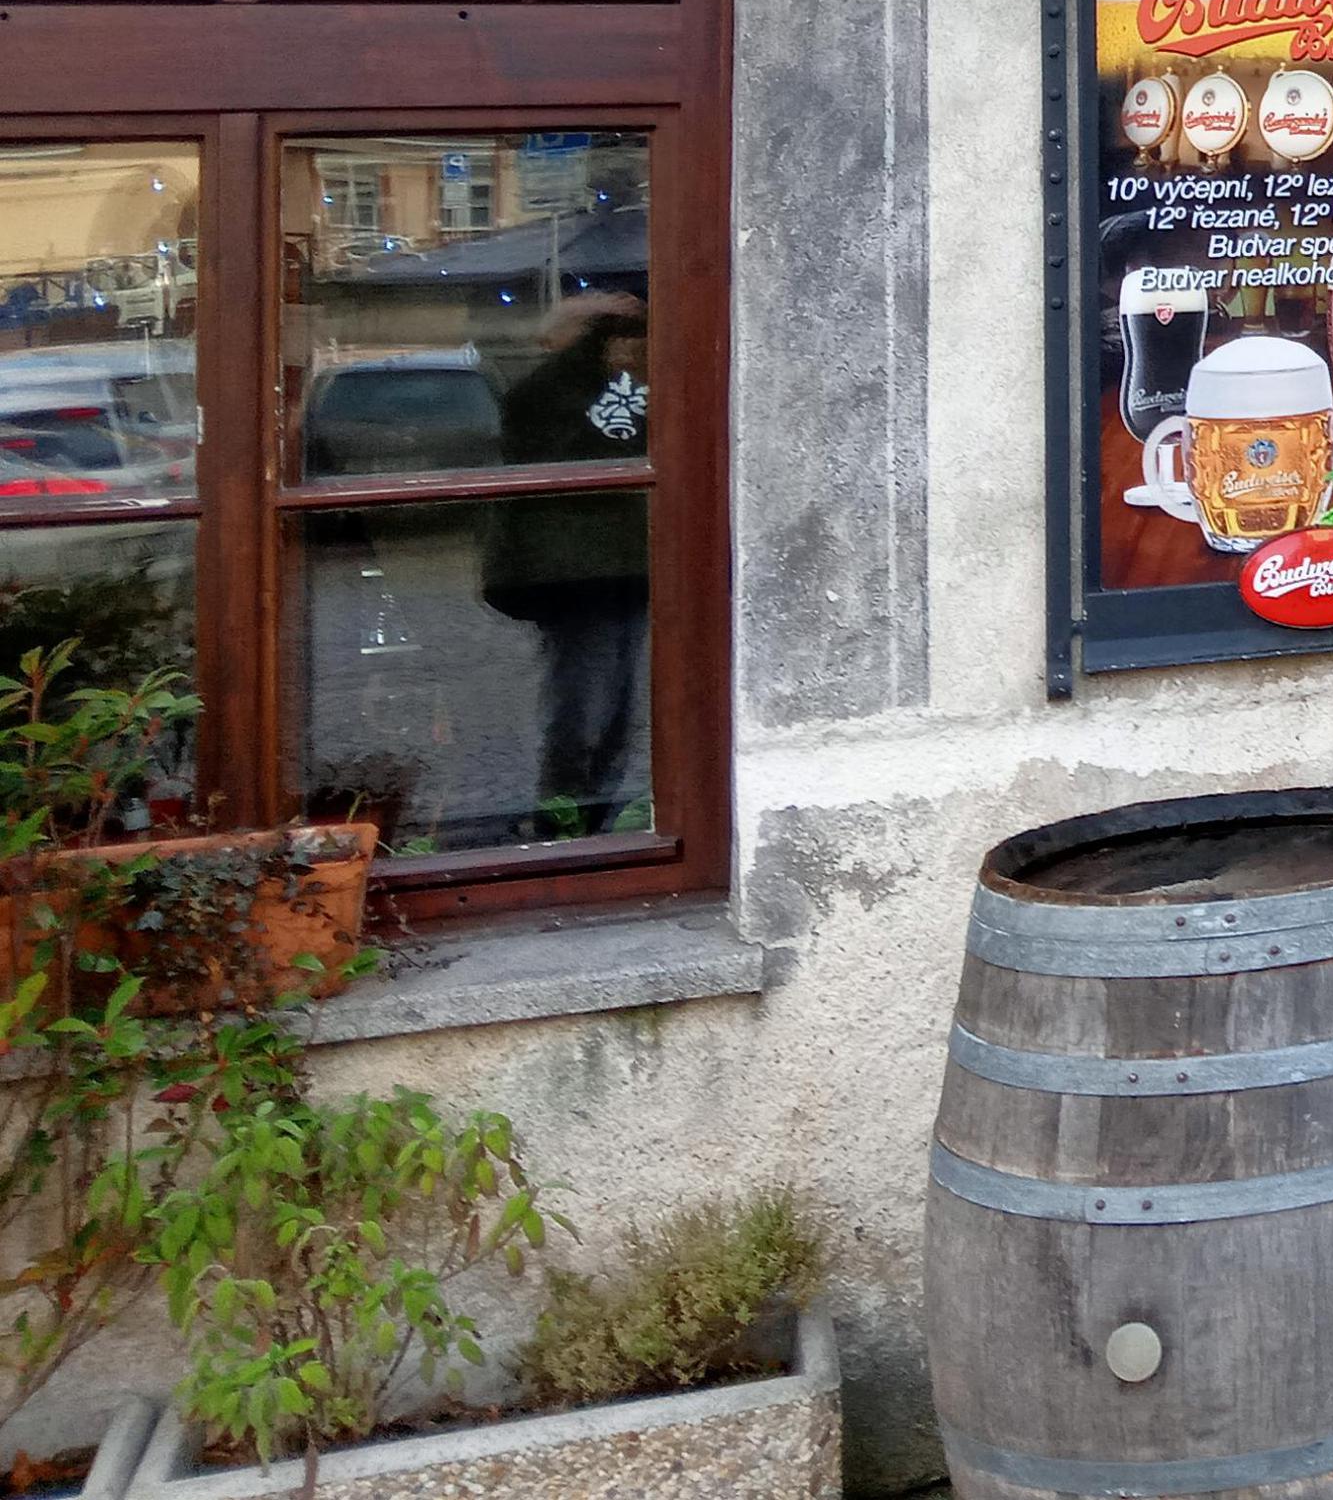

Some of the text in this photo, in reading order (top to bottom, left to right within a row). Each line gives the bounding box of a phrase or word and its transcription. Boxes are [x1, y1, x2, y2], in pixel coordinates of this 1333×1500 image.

[1154, 174, 1253, 205] výčepní,
[1191, 203, 1280, 230] řezané,
[1208, 233, 1297, 258] Budvar
[1140, 265, 1228, 291] Budvar
